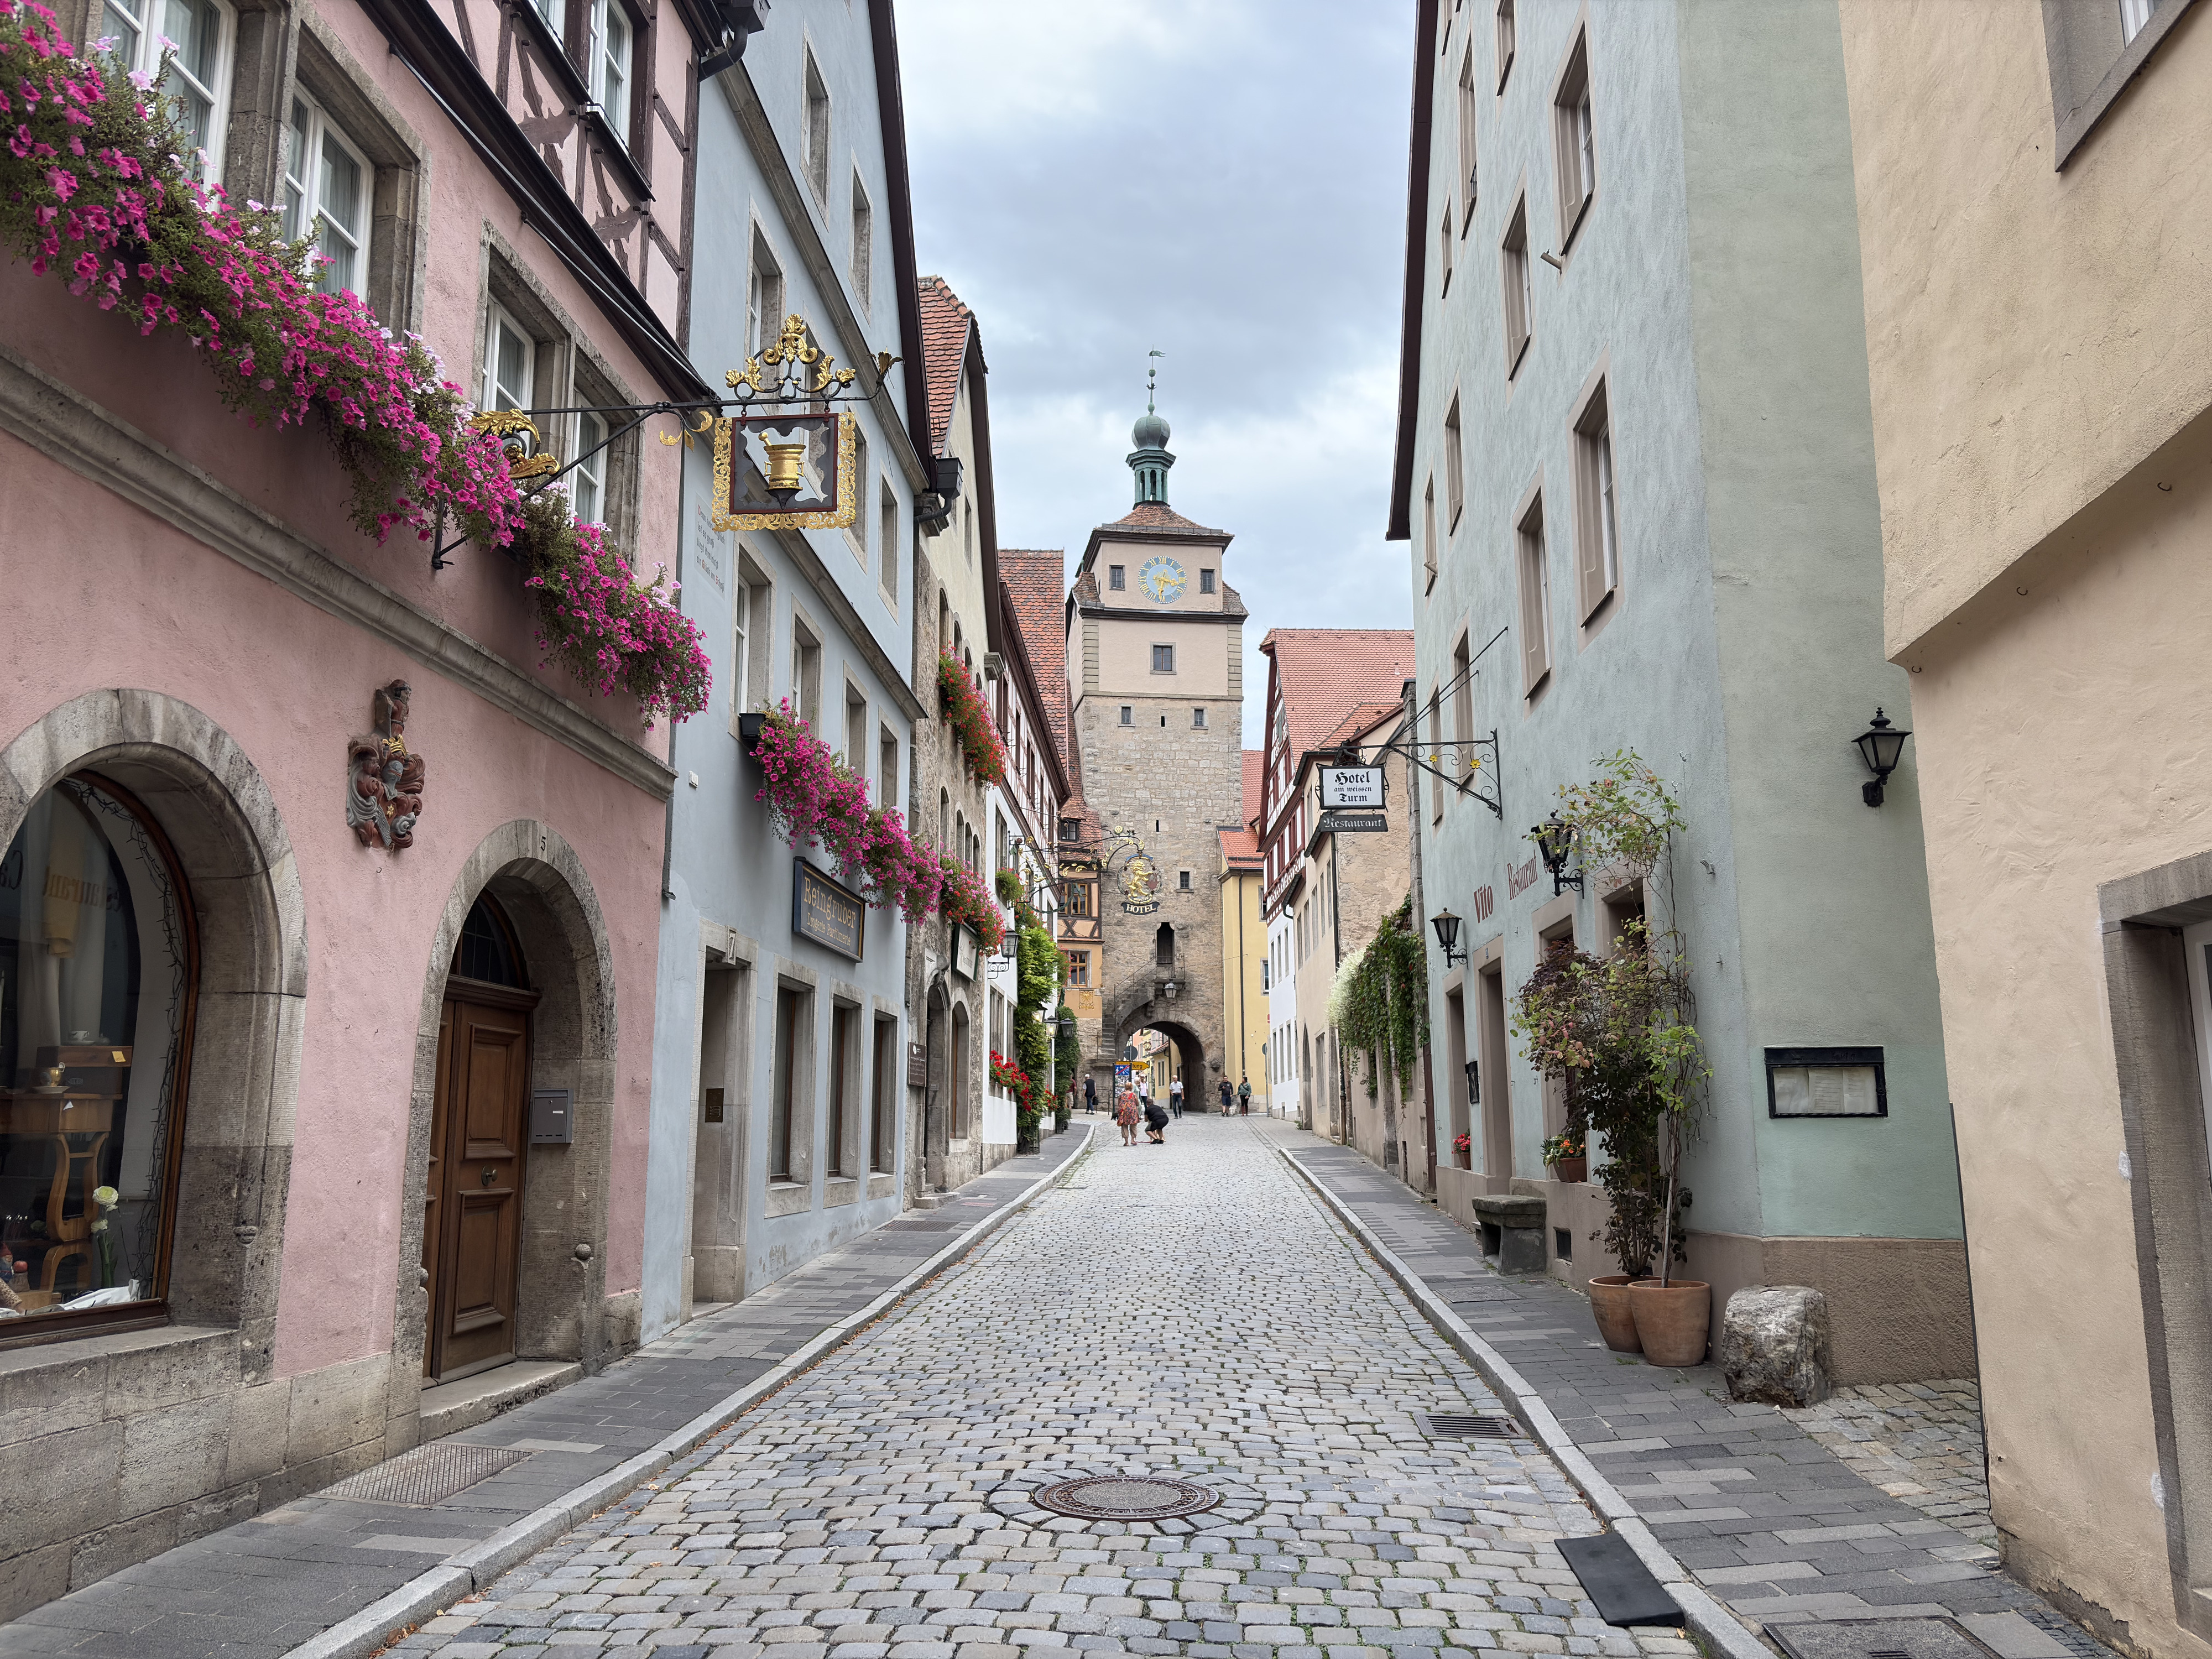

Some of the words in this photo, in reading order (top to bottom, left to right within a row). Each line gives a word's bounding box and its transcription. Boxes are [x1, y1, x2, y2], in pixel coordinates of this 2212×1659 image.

[1334, 770, 1370, 787] Hotel
[1339, 793, 1368, 802] Turm
[1323, 818, 1382, 828] Restaurant
[540, 836, 546, 852] 5
[1507, 849, 1538, 901] Restaurant
[804, 876, 856, 929] Reingruber
[1126, 904, 1156, 914] HOTEL
[1473, 884, 1493, 924] Vito
[807, 912, 826, 933] Drogerie
[827, 923, 851, 946] Parfümerie
